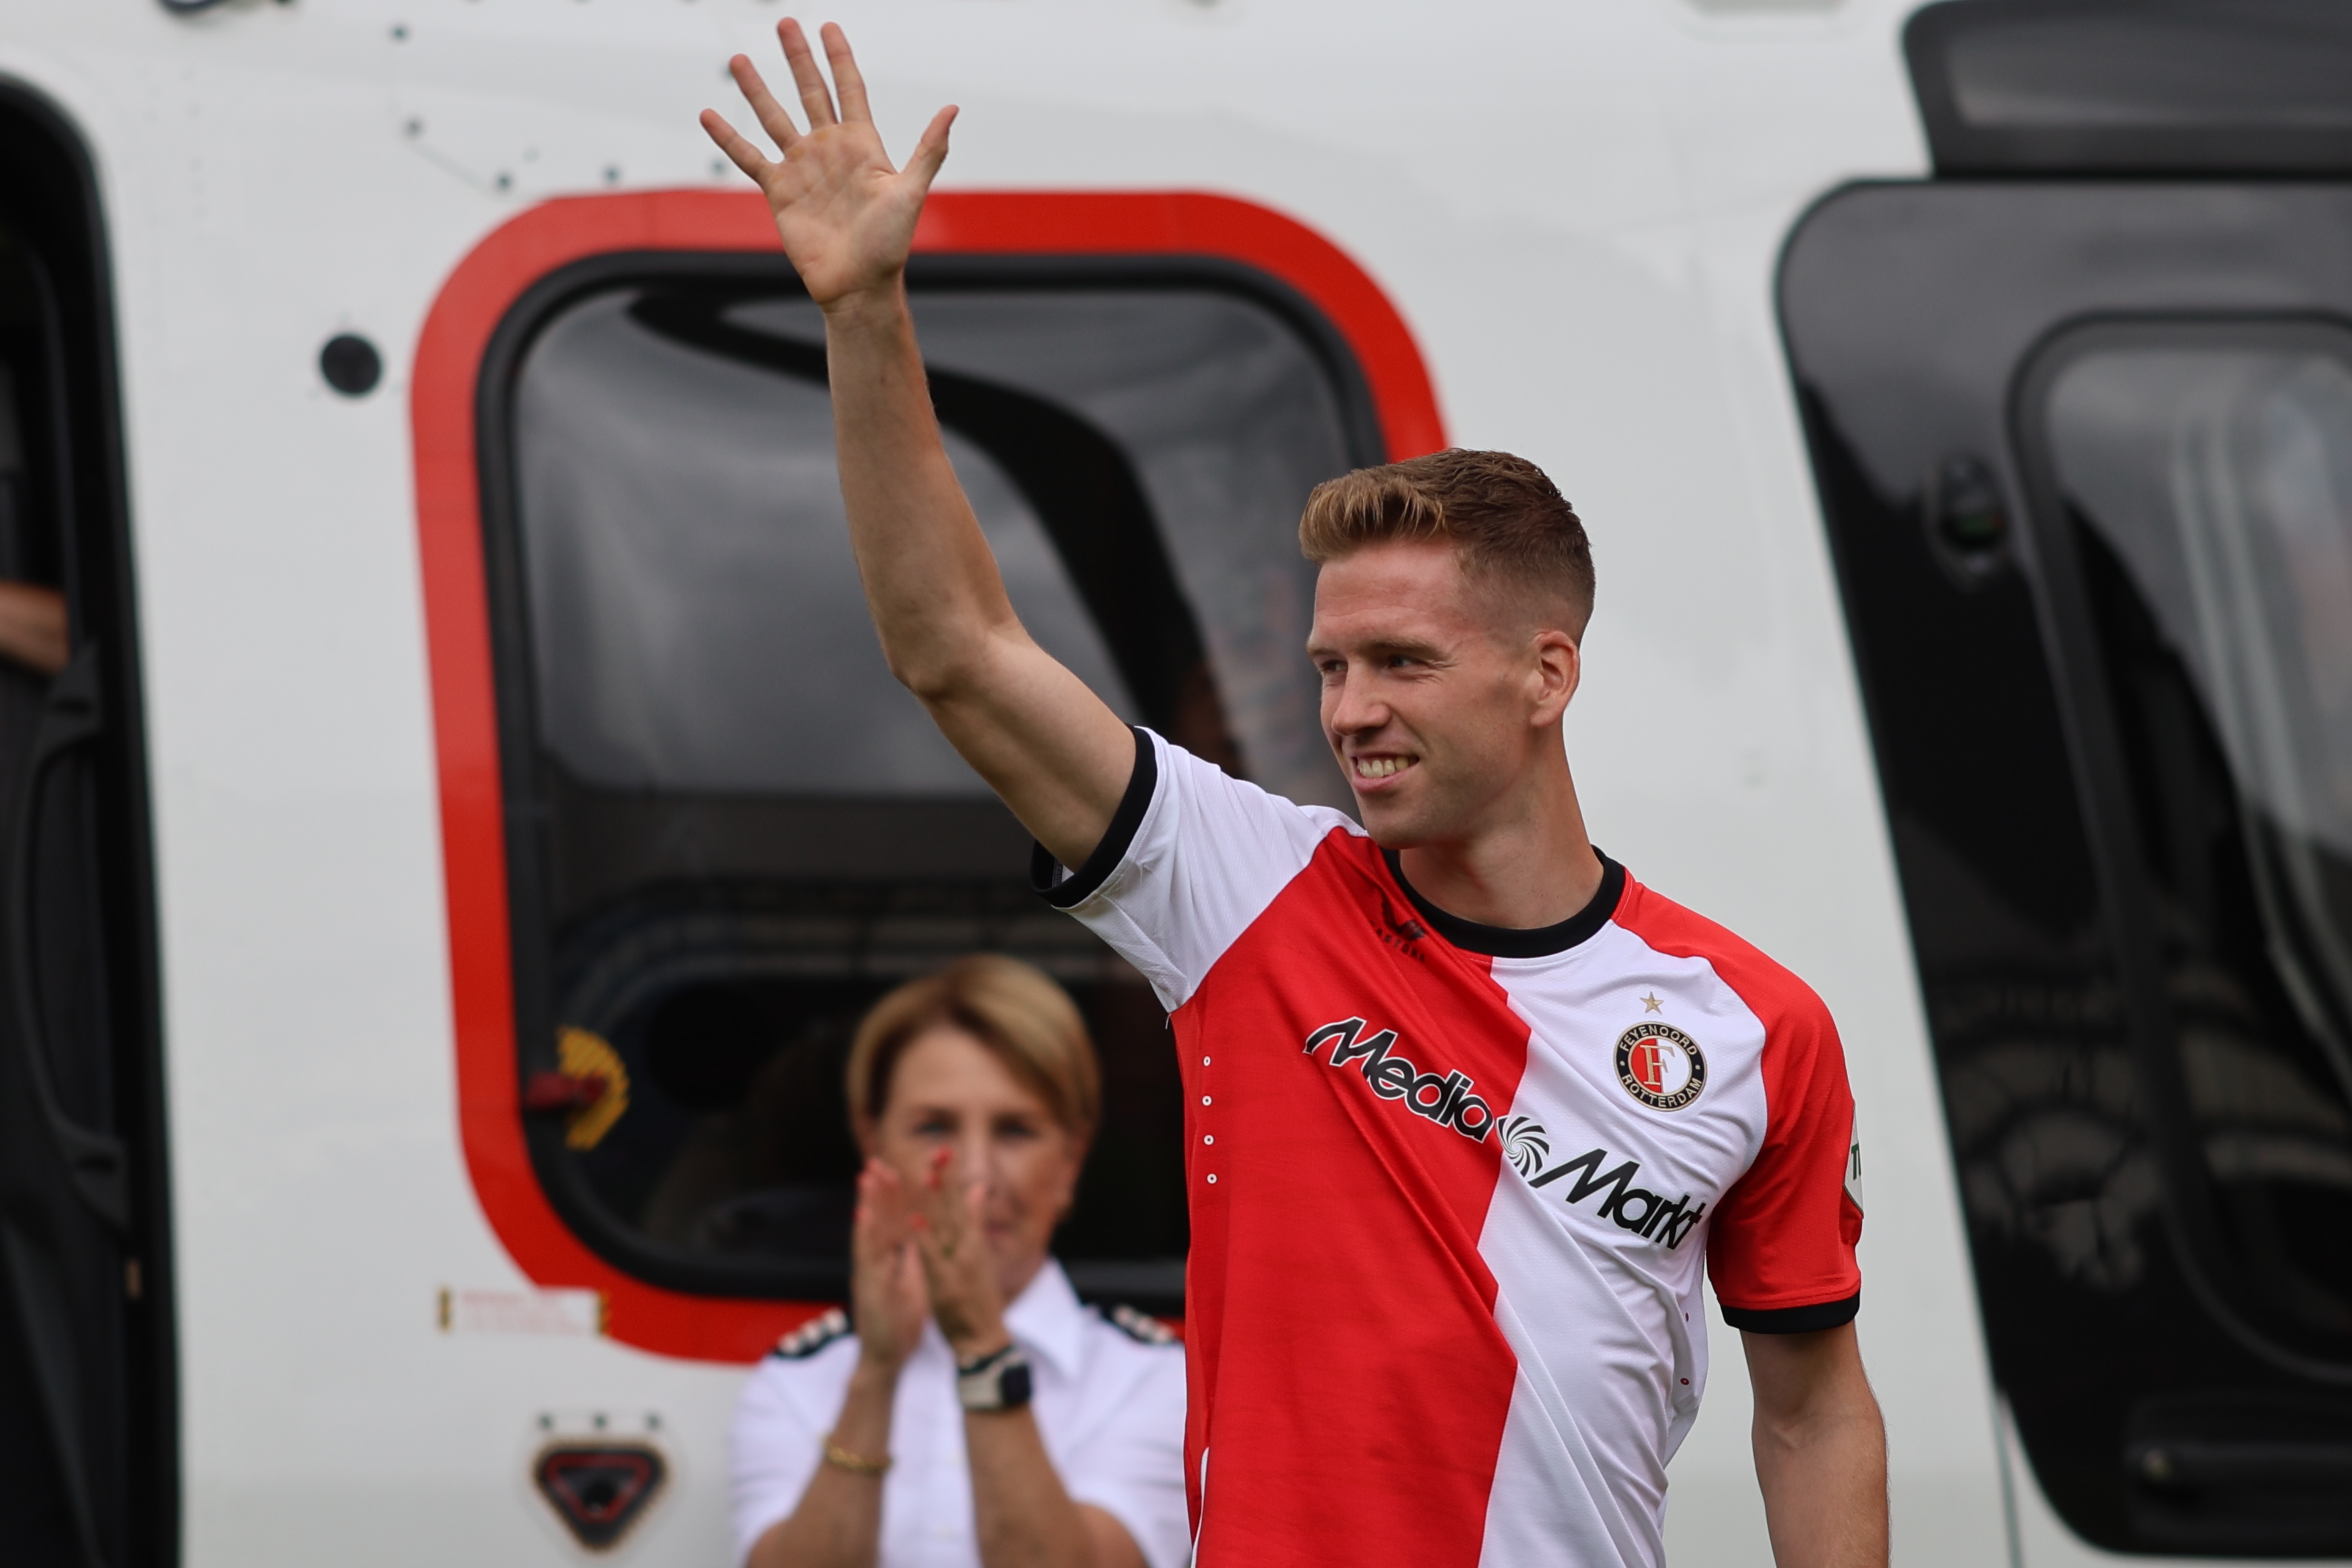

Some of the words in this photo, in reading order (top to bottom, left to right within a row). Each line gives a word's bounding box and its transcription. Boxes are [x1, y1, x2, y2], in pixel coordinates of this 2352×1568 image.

[1620, 1025, 1697, 1052] FEYENOORD
[1640, 1045, 1675, 1085] F
[1622, 1074, 1702, 1107] ROTTERDAM
[1303, 1016, 1495, 1143] Media
[1527, 1148, 1707, 1250] Markt
